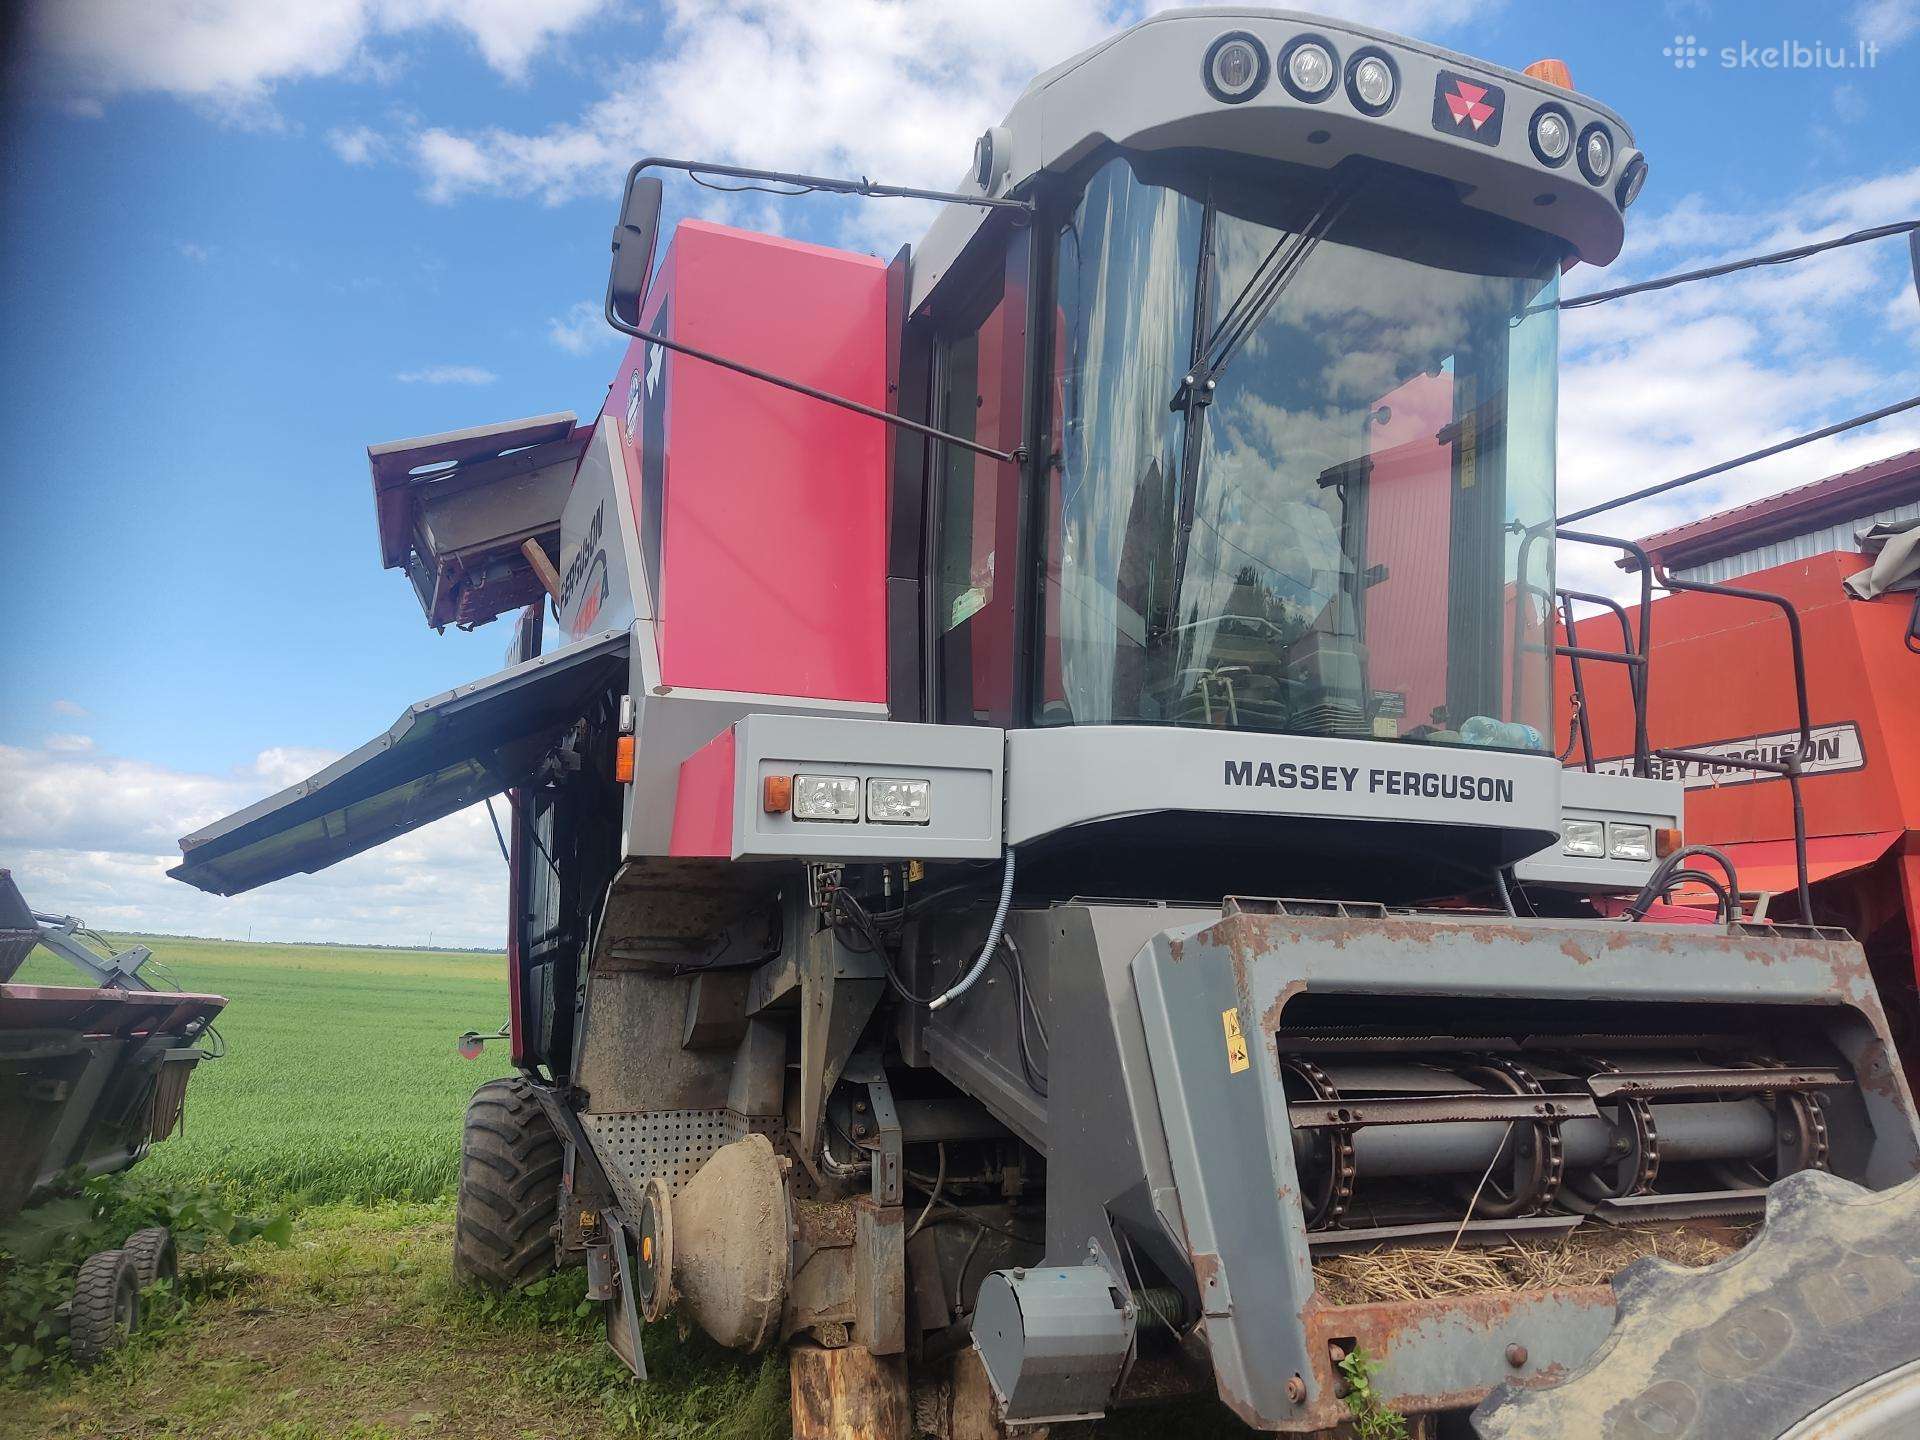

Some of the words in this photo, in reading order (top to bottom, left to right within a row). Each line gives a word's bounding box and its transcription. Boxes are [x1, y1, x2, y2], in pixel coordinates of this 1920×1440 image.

[1224, 760, 1359, 791] MASSEY
[1369, 769, 1513, 802] FERGUSON
[1599, 760, 1689, 781] SEY
